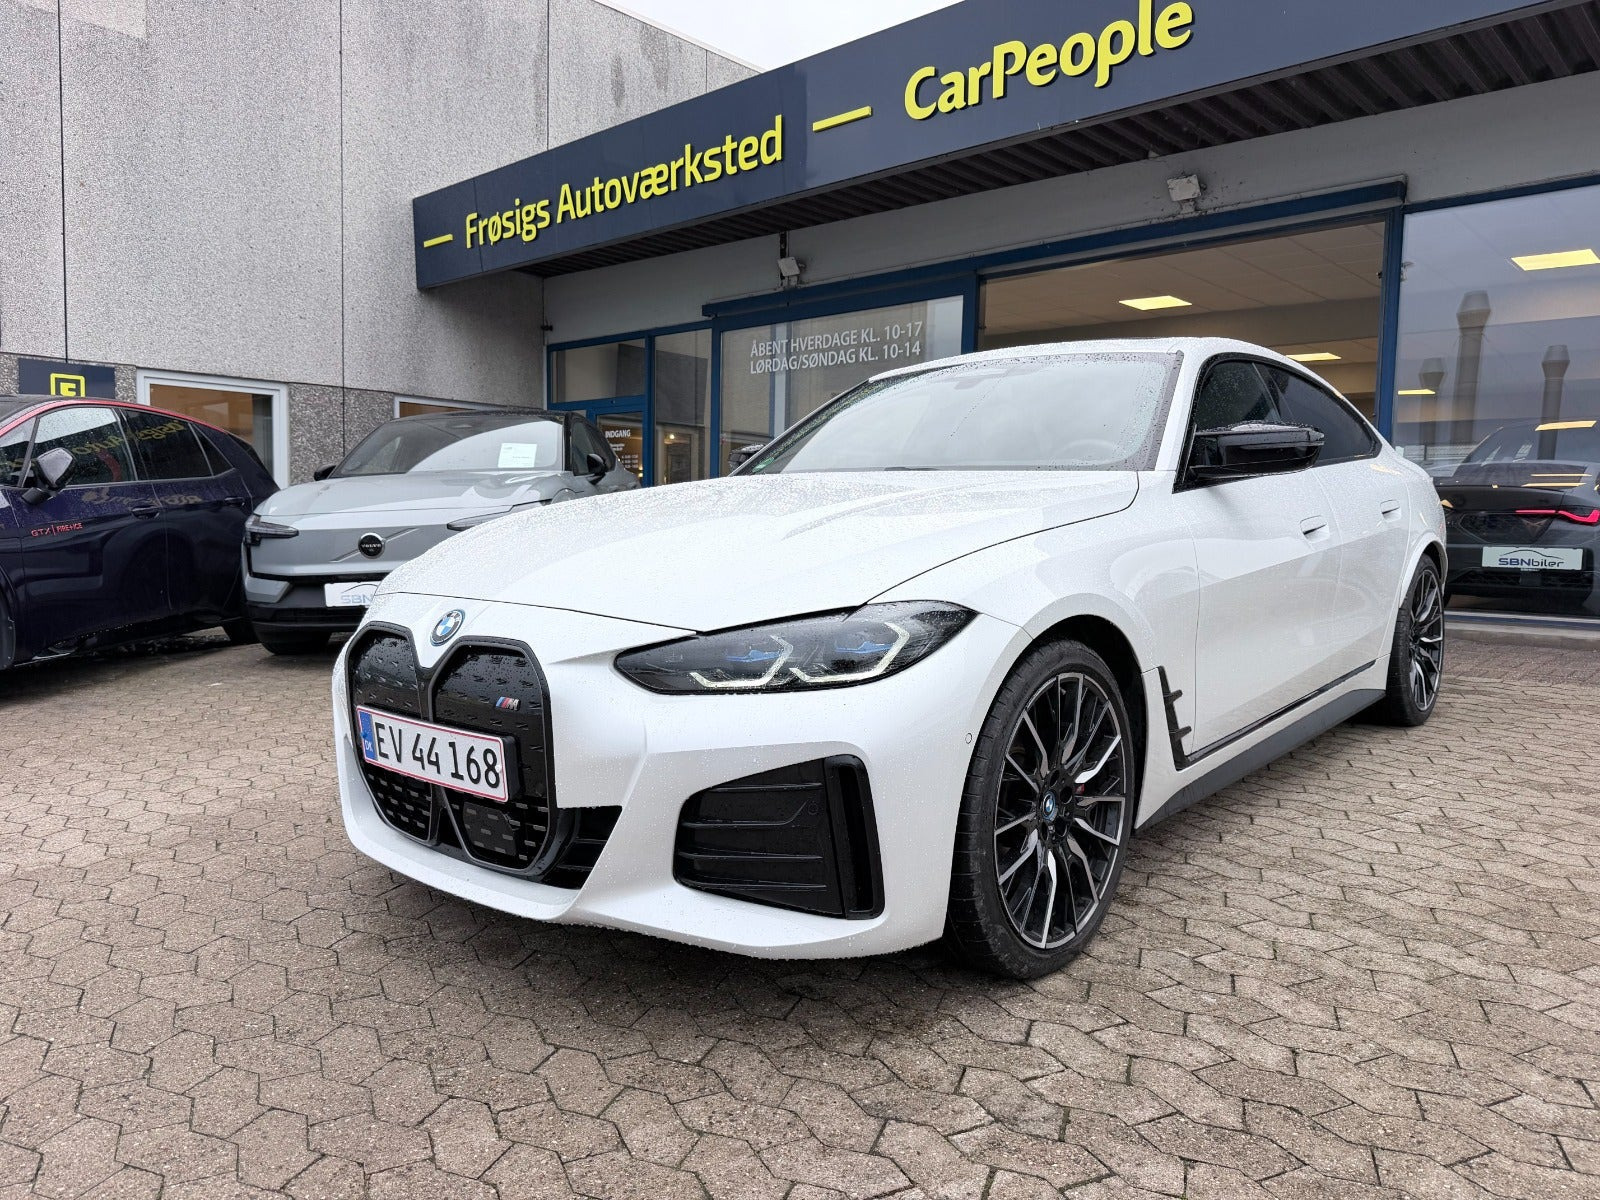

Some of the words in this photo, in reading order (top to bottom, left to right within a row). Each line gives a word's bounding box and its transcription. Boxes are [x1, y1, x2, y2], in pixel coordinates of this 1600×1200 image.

[904, 0, 1193, 120] CarPeople
[465, 198, 551, 248] Frøsigs
[556, 114, 783, 224] Autoværksted
[750, 339, 788, 358] ÅBENT
[790, 330, 858, 352] HVERDAGE
[861, 327, 881, 343] KL.
[884, 320, 923, 340] 10-17
[750, 348, 856, 375] LØRDAG/SØNDAG
[859, 346, 879, 362] KL.
[882, 340, 921, 360] 10-14
[605, 430, 630, 438] INDGANG
[1498, 557, 1564, 568] SBNbiler
[375, 722, 402, 763] EV
[412, 733, 441, 774] 44
[448, 742, 500, 789] 168
